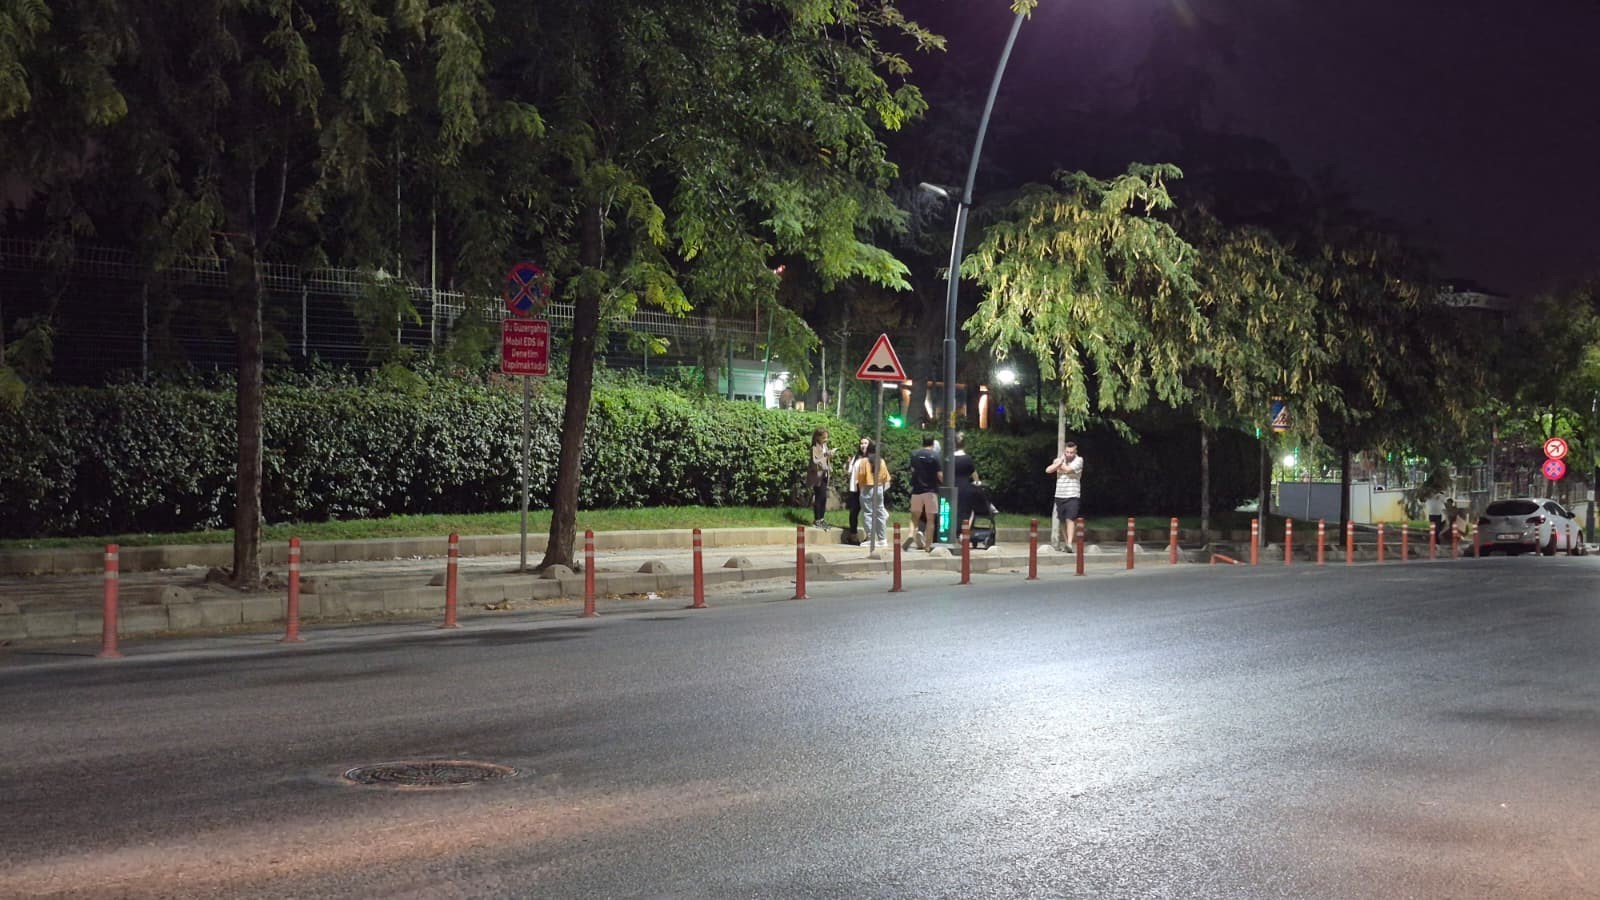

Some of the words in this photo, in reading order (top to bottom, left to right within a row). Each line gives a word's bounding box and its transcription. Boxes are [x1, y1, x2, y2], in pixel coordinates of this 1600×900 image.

[505, 336, 522, 346] Mobil
[523, 336, 536, 347] EDS
[511, 348, 539, 359] Denetim
